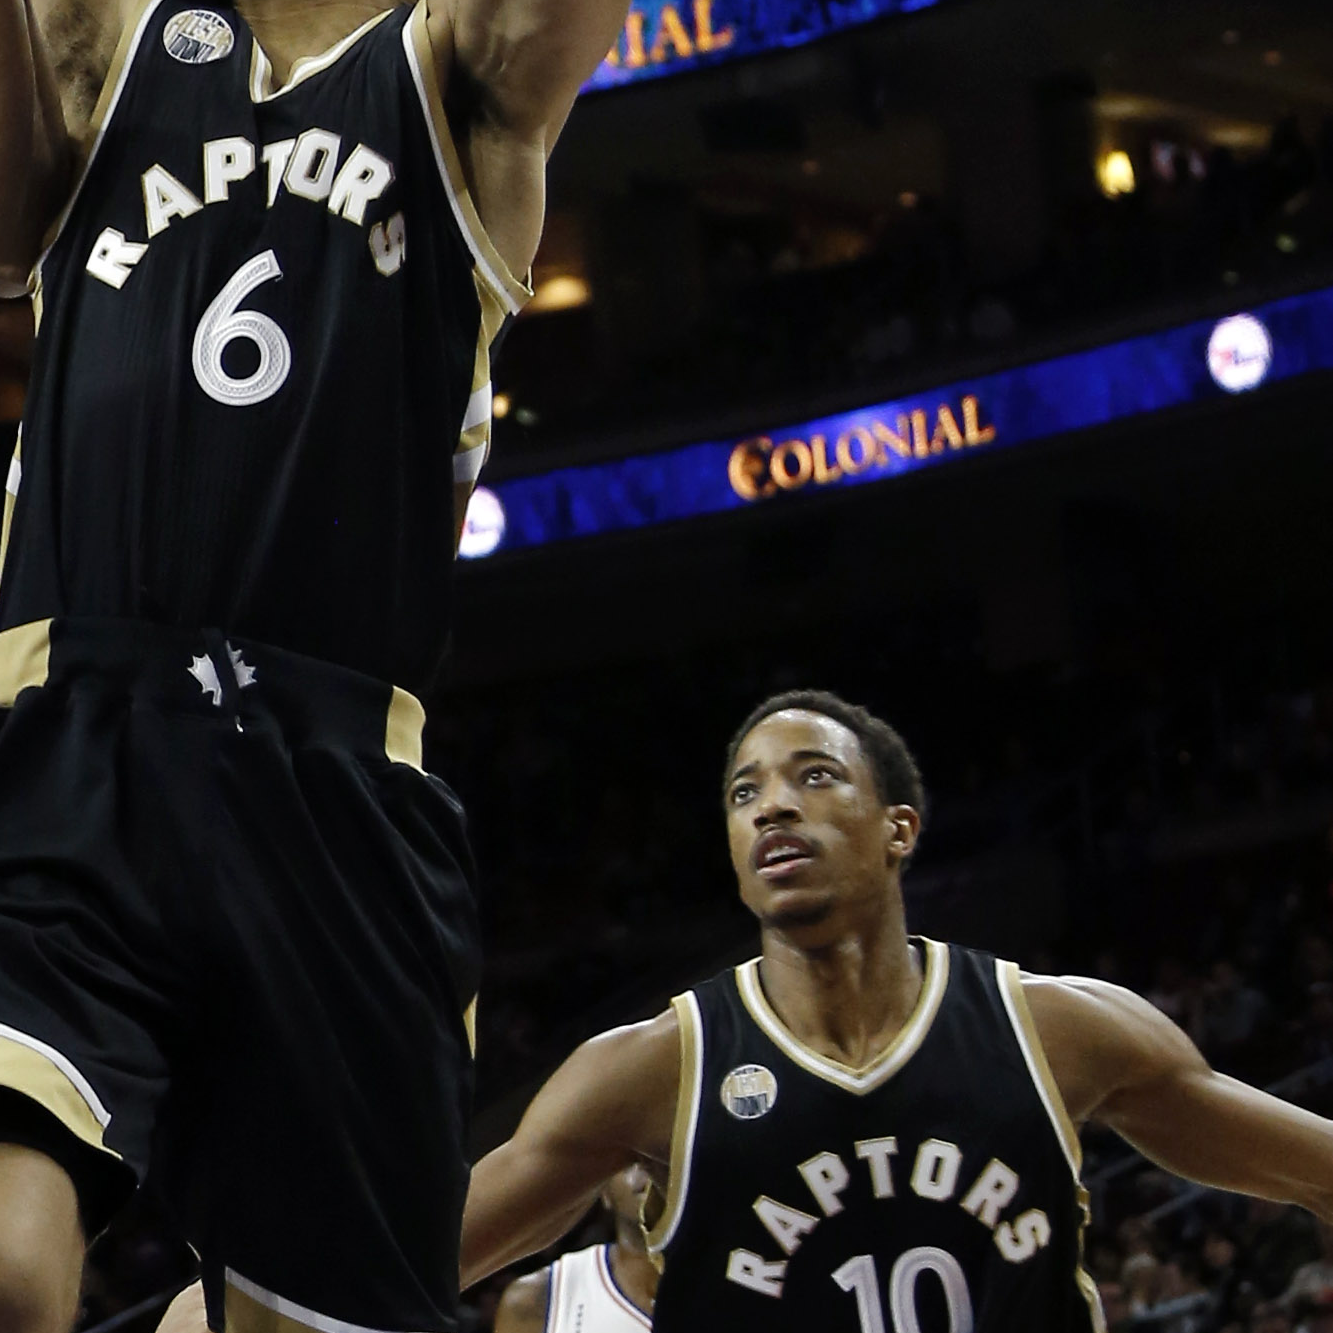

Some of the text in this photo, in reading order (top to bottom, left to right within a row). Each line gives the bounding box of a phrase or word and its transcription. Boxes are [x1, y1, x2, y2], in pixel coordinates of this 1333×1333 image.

[86, 127, 406, 290] RAPTORS
[192, 249, 292, 407] 6
[726, 1137, 1051, 1300] RAPTORS
